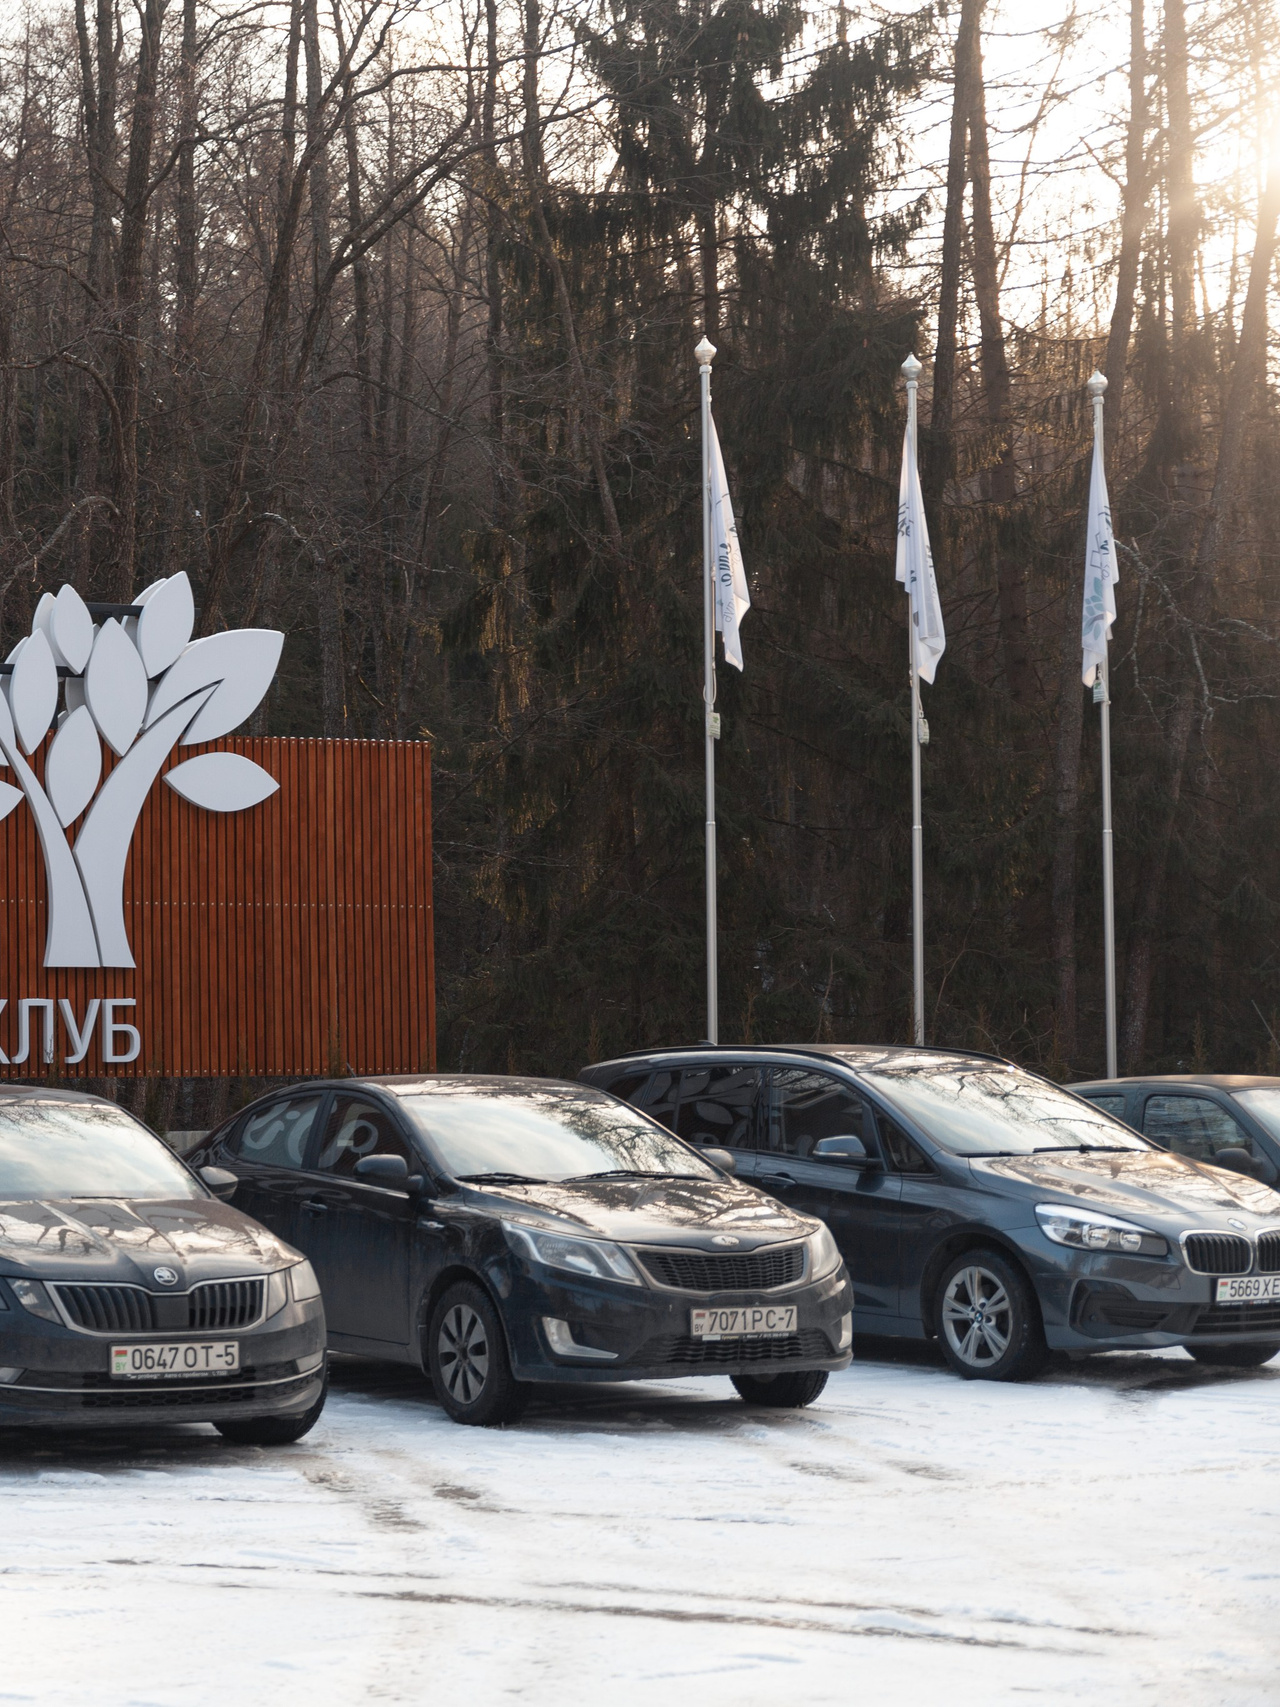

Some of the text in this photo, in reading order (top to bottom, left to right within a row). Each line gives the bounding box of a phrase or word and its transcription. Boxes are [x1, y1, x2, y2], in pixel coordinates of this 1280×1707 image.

[1229, 1279, 1260, 1298] 5669
[694, 1324, 704, 1332] BY
[708, 1308, 794, 1332] 7071 PC-7
[115, 1361, 127, 1371] BY
[131, 1344, 235, 1370] 0647 OT-5
